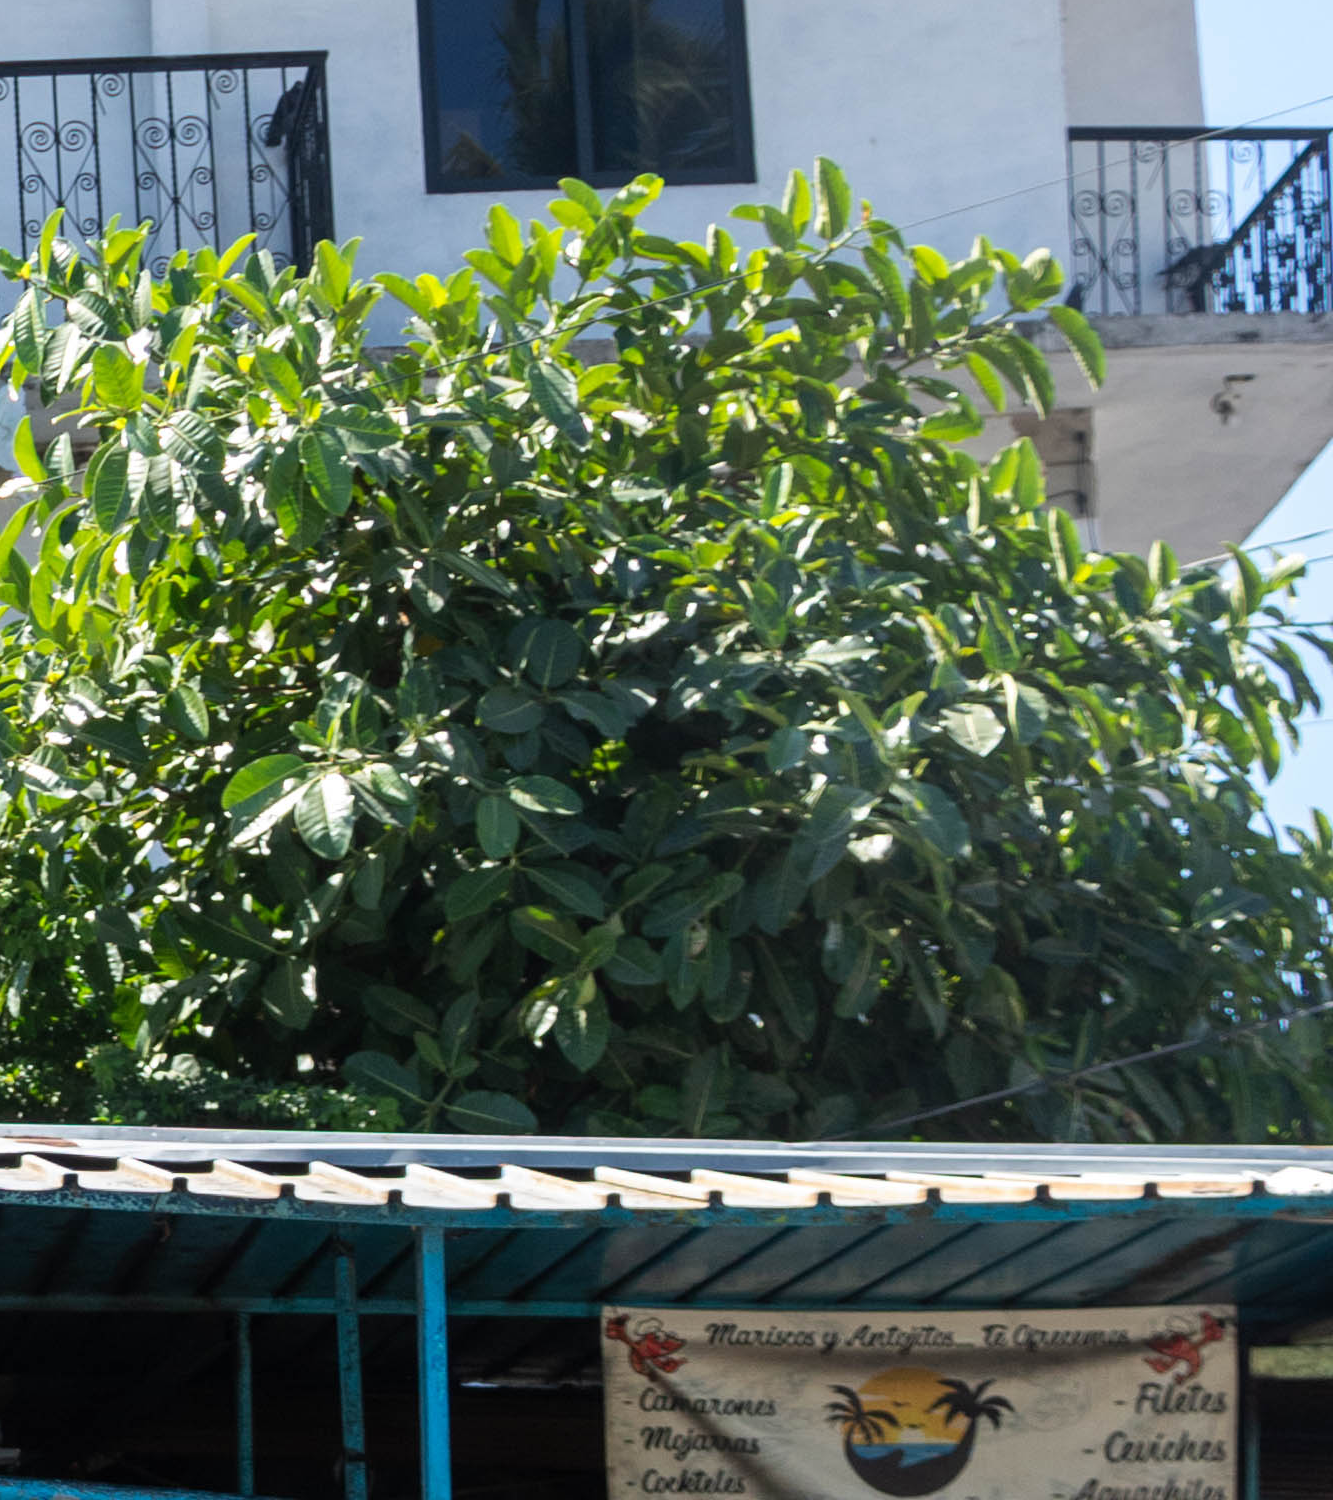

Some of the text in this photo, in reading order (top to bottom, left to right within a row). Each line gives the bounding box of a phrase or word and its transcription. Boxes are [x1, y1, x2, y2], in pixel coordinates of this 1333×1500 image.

[639, 1387, 777, 1417] Camarones
[1134, 1382, 1228, 1415] Filetes
[1103, 1430, 1228, 1463] Ceviches
